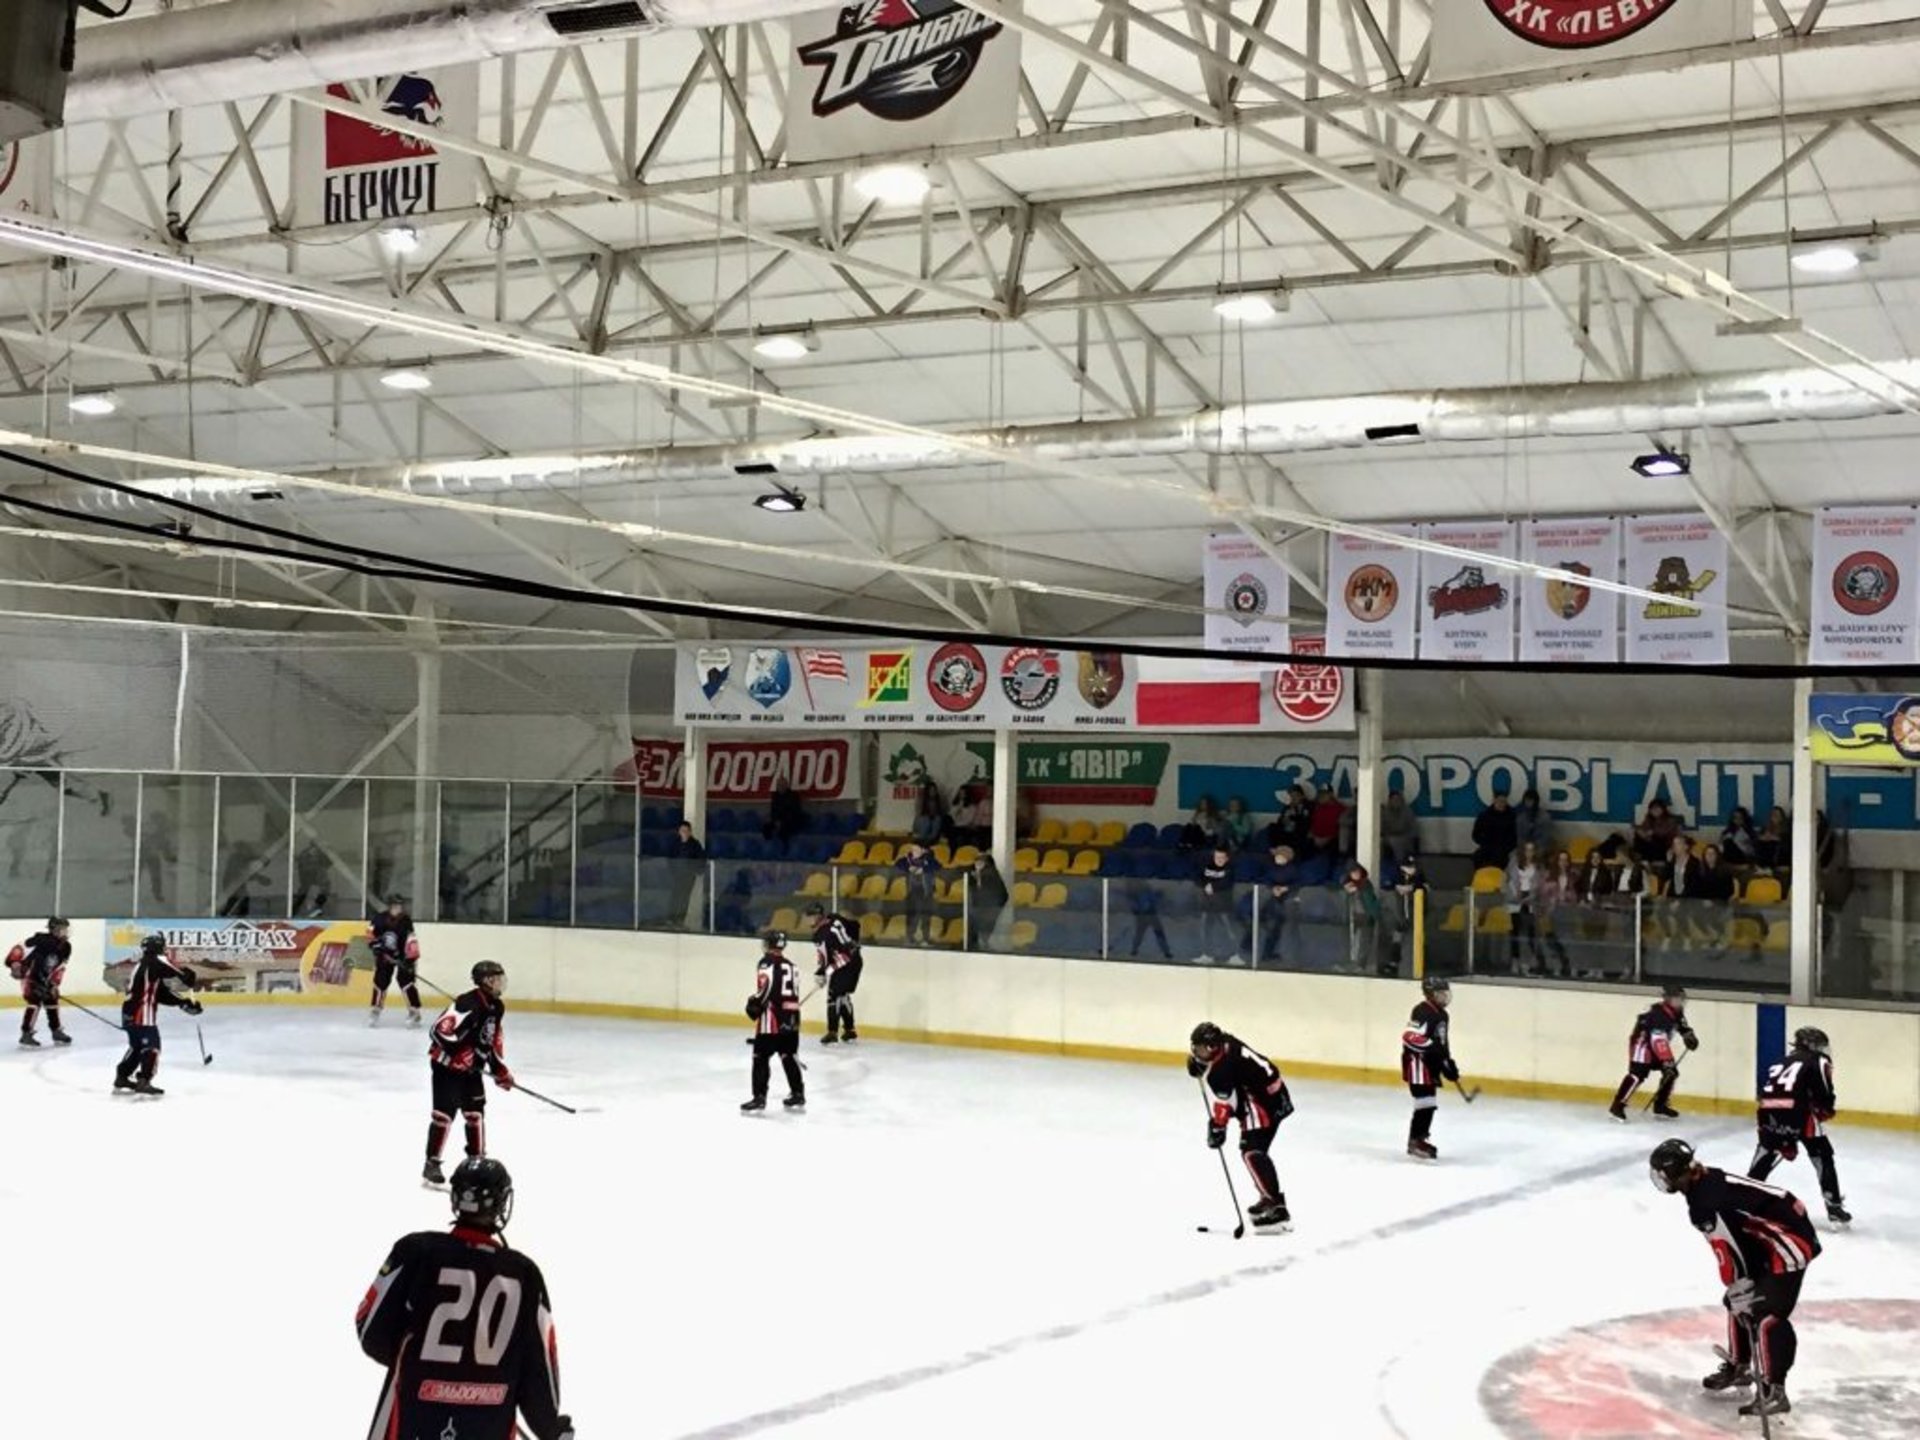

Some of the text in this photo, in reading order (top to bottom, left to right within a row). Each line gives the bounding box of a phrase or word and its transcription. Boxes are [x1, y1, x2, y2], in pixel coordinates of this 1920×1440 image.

[1505, 0, 1552, 32] ХК
[325, 162, 439, 226] БЕРКУТ
[1281, 678, 1335, 692] PZHL
[419, 1267, 523, 1366] 20
